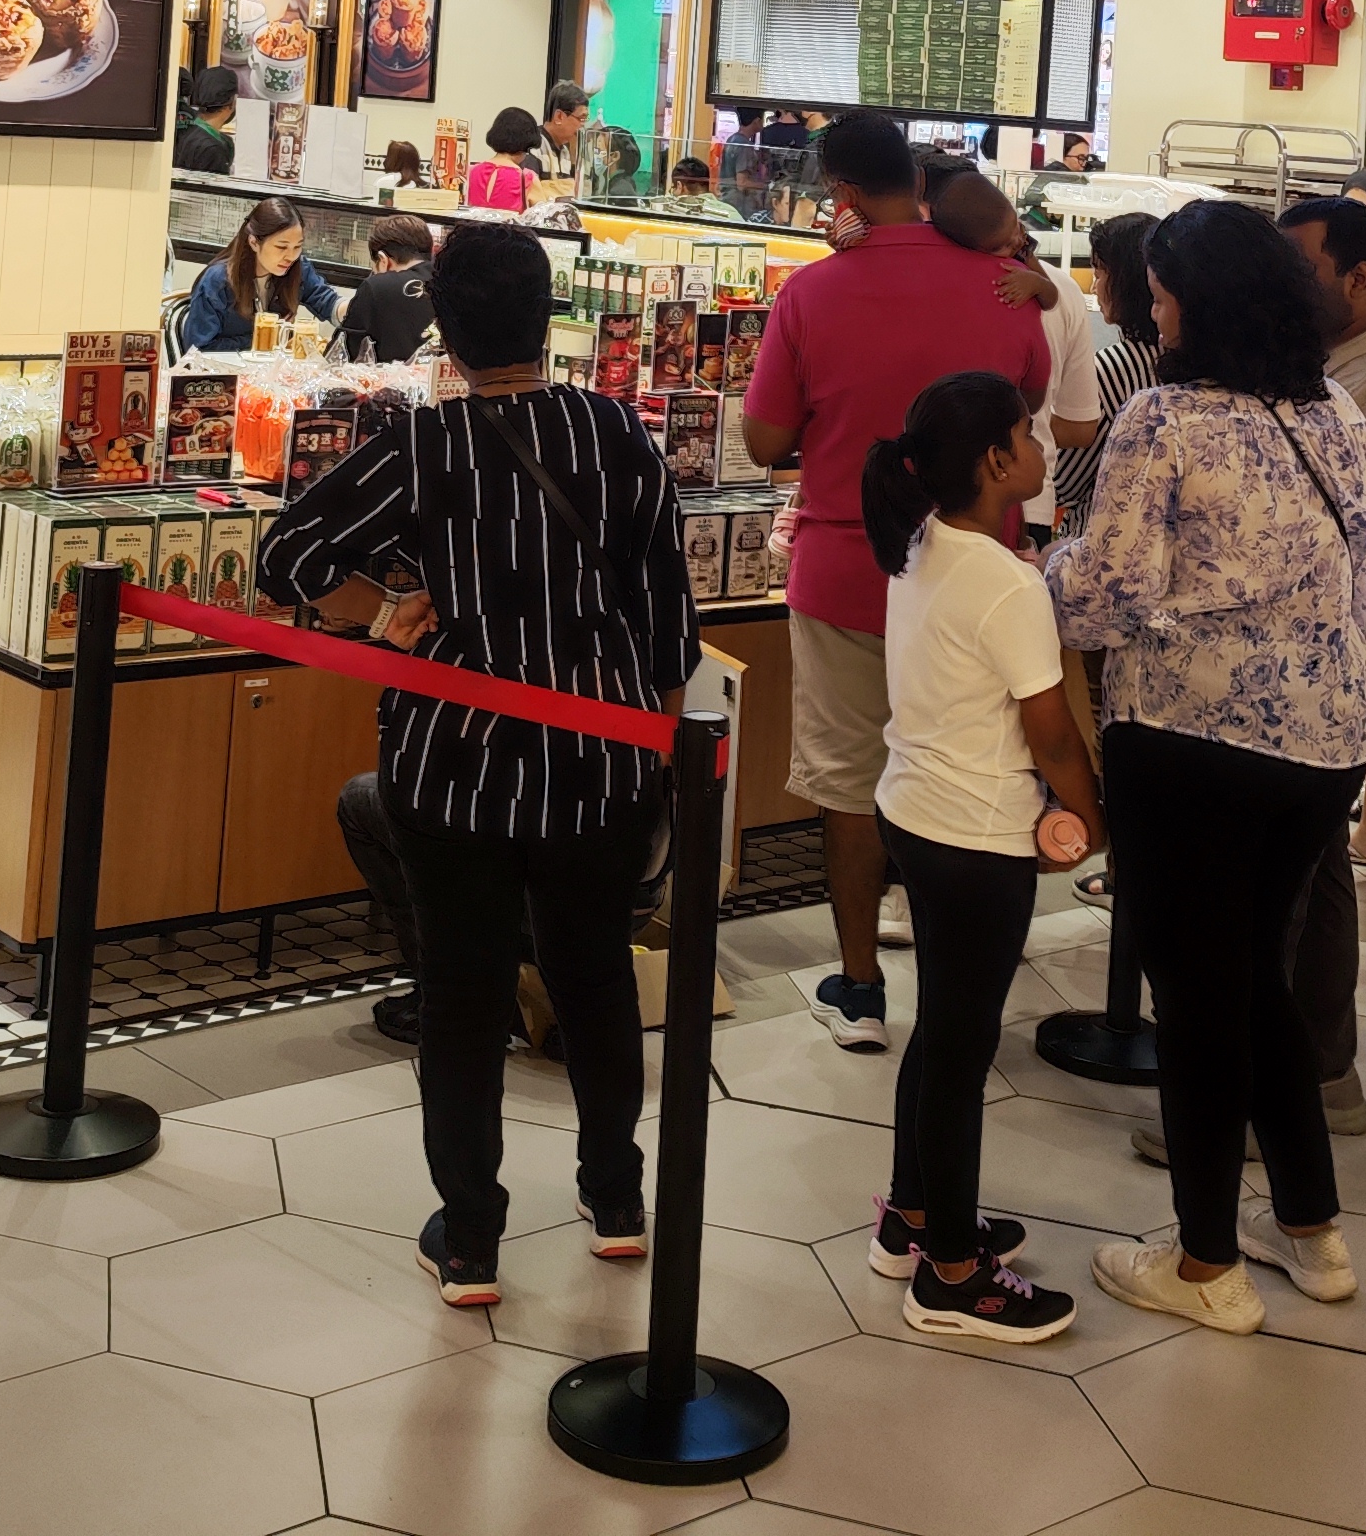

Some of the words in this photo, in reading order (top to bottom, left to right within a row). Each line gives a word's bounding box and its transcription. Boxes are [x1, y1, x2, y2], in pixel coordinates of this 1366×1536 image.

[68, 334, 100, 349] BUY
[102, 334, 111, 349] 5
[67, 350, 86, 360] GET
[94, 349, 116, 359] FREE
